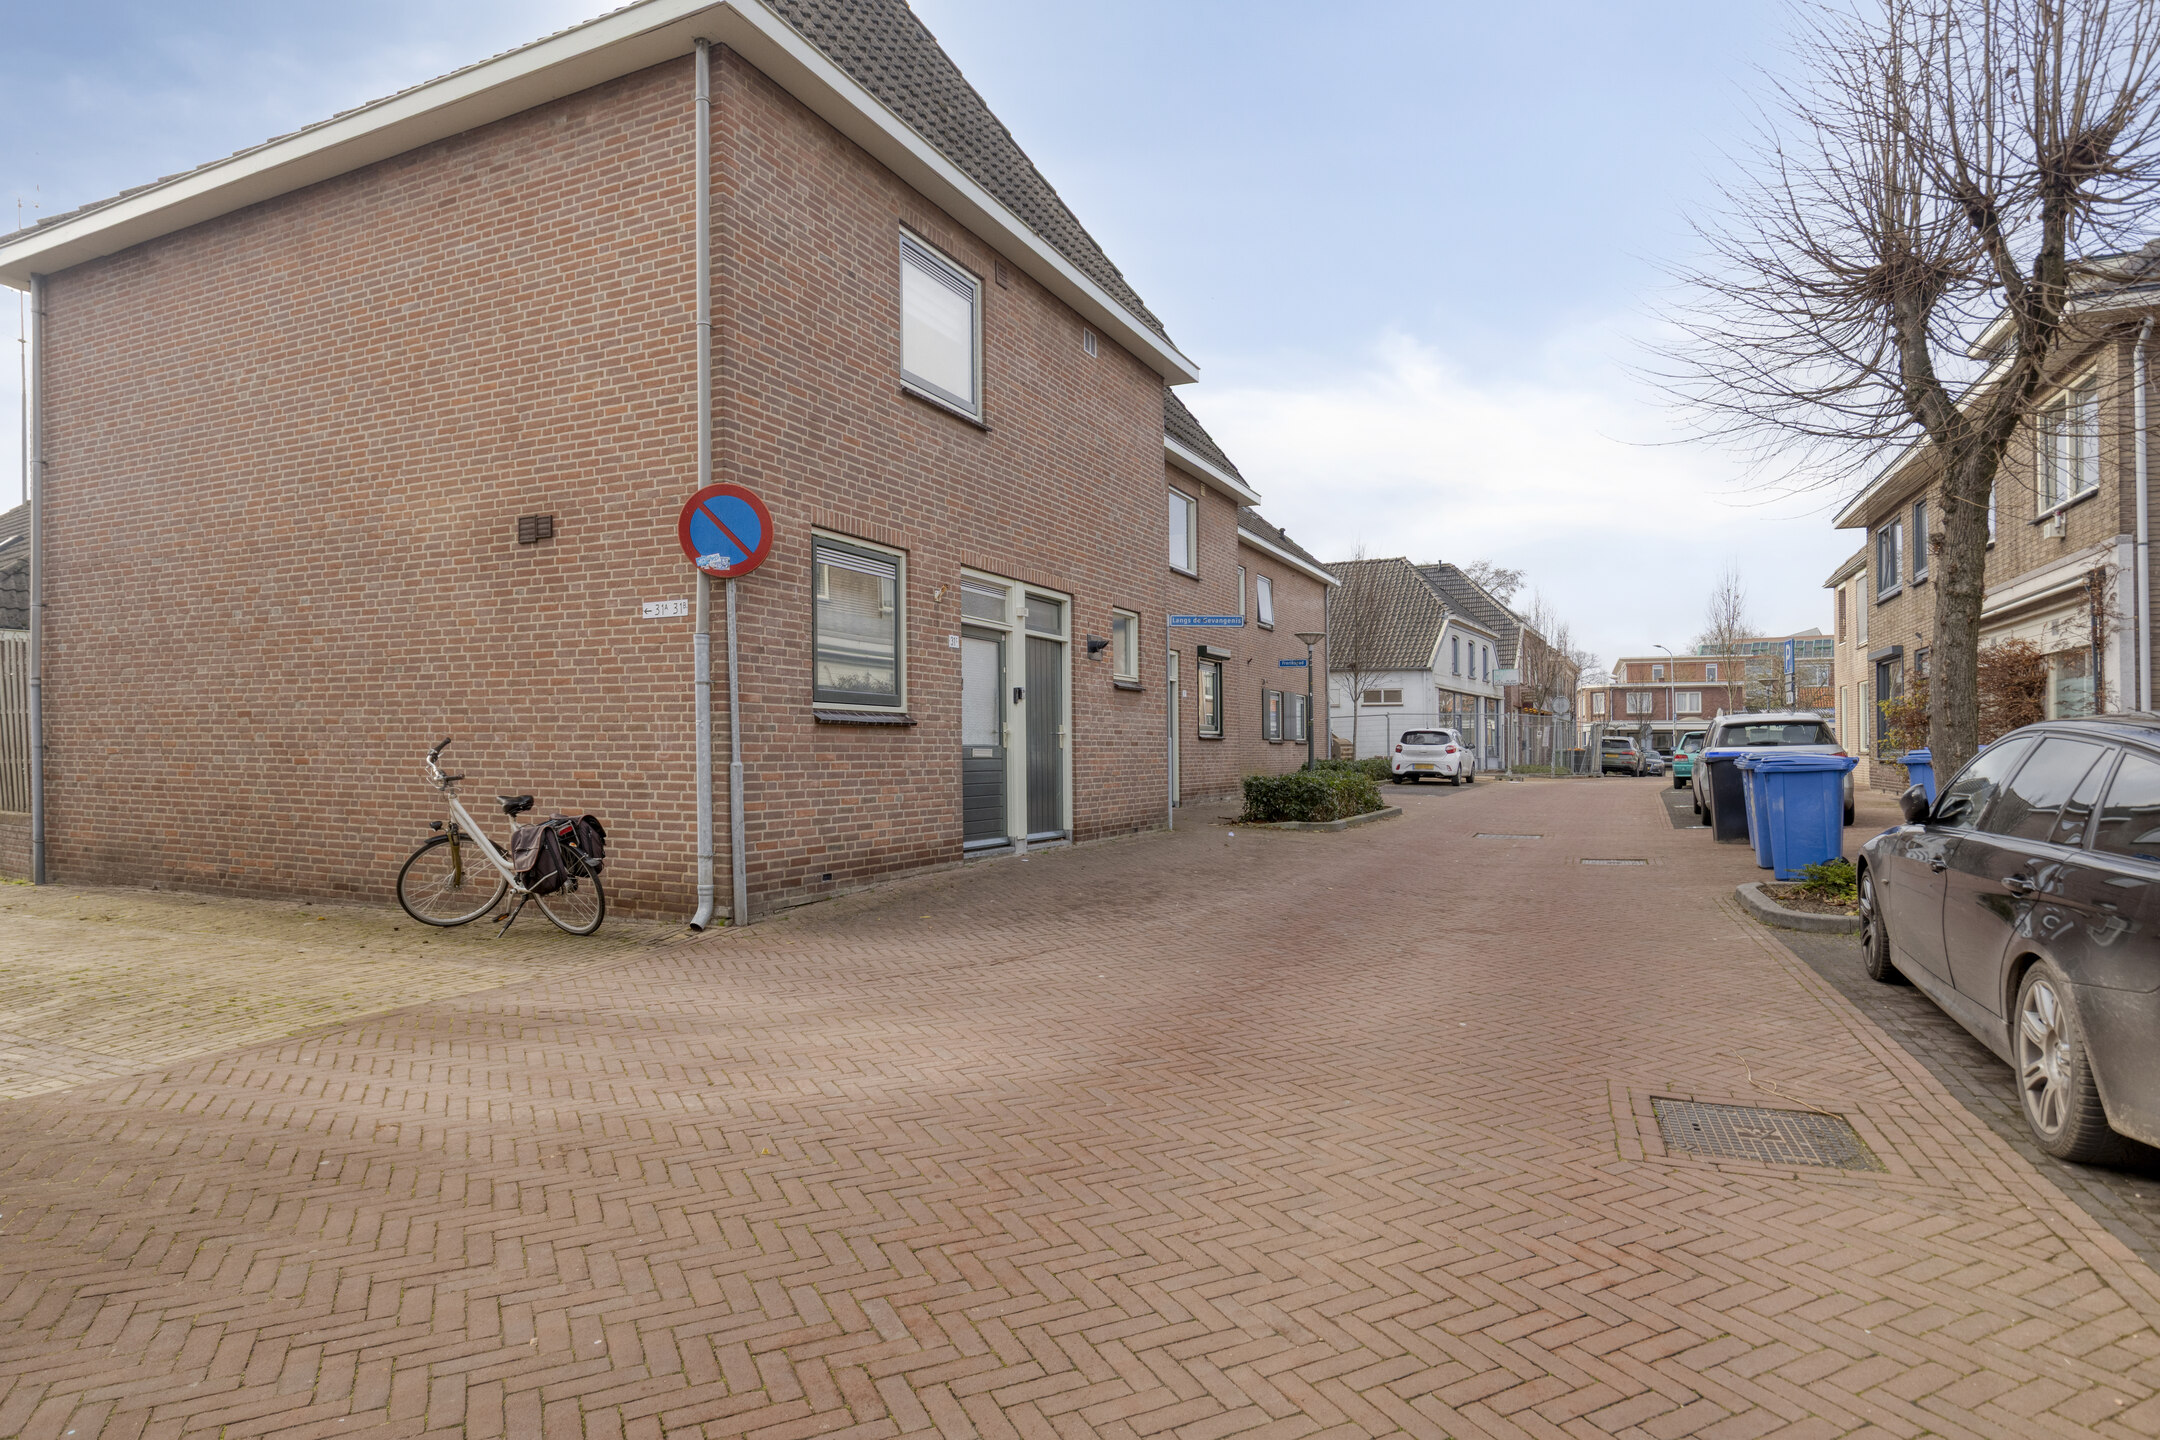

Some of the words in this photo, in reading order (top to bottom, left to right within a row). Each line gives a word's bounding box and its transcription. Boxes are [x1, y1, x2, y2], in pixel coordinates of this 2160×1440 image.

[655, 604, 668, 616] 31A
[673, 602, 687, 614] 31B
[1172, 617, 1191, 625] Langs
[1203, 617, 1241, 625] Gevangenis
[1785, 644, 1791, 670] P
